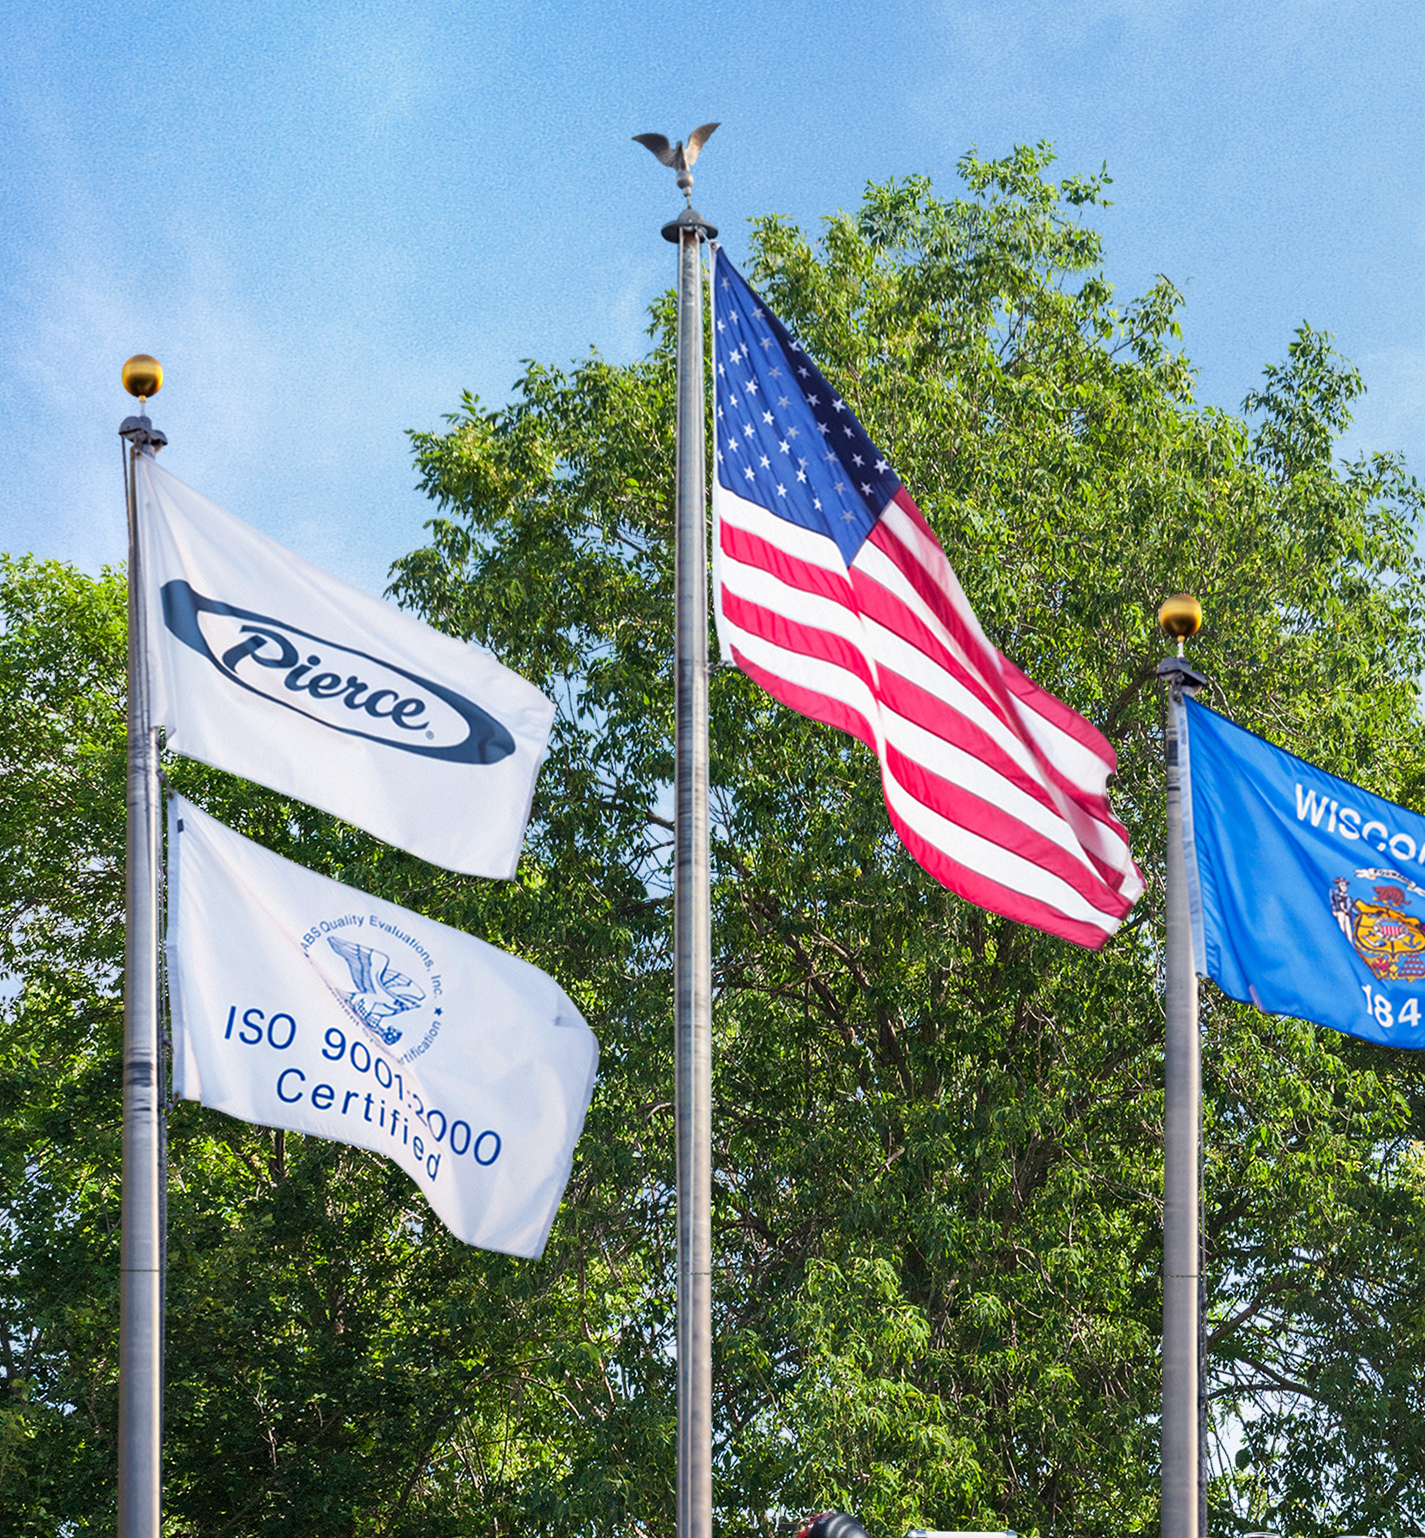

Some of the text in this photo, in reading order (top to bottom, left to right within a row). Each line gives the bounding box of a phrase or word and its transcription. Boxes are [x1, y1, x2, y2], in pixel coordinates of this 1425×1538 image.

[221, 624, 429, 730] Pierce
[300, 914, 443, 999] ABS Quality Evaluations, Inc.
[224, 1005, 297, 1050] ISO
[321, 1027, 502, 1166] 9001:2000
[276, 1068, 442, 1182] Certified
